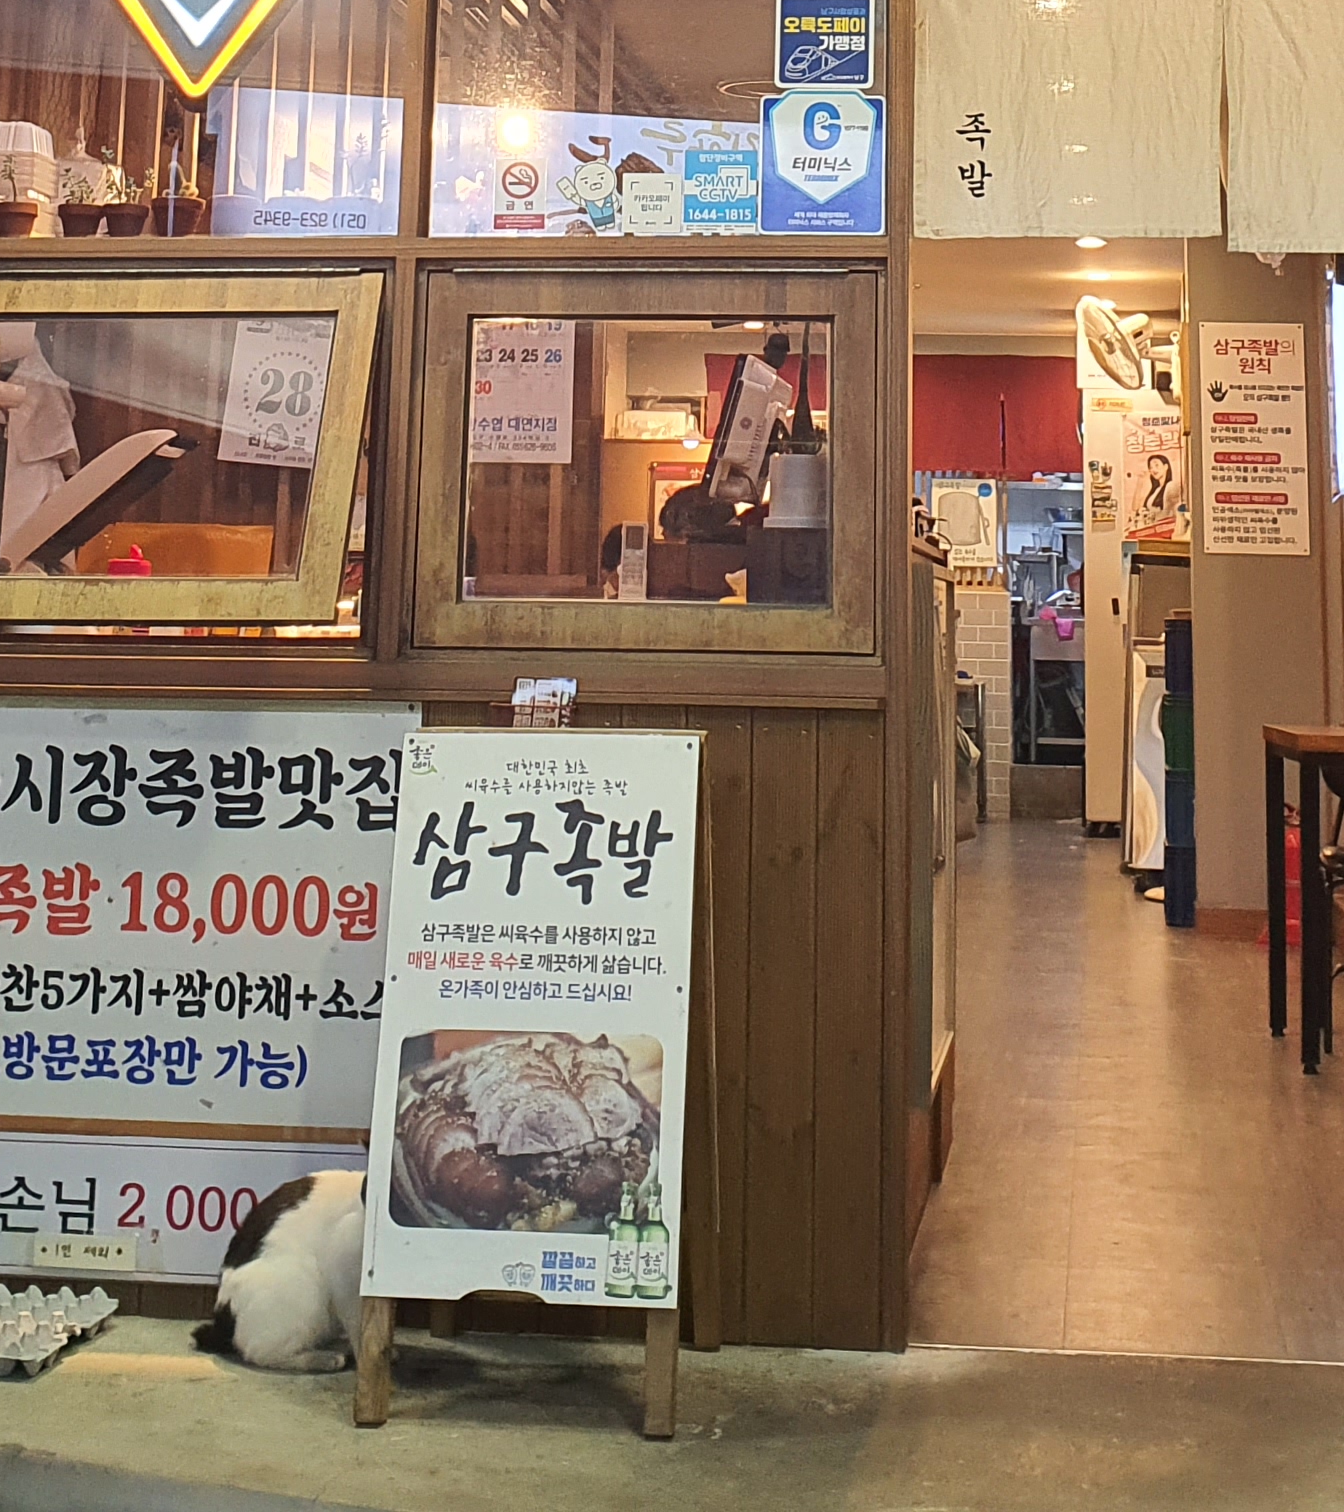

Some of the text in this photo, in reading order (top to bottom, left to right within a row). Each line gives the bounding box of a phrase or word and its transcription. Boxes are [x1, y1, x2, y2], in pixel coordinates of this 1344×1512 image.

[818, 35, 866, 51] 가맹점
[792, 156, 852, 172] 터미닉스
[955, 111, 994, 199] 족발
[694, 175, 744, 188] SMART
[699, 188, 738, 202] CCTV
[687, 208, 752, 221] 1644-1815
[498, 348, 516, 363] 24
[521, 348, 539, 363] 25
[544, 349, 563, 363] 26
[1213, 338, 1296, 357] 삼구족발의
[1238, 357, 1272, 375] 원칙
[255, 368, 315, 417] 28
[474, 380, 493, 395] 30
[508, 416, 558, 433] 대연지점
[505, 759, 590, 776] 대한민국 최초
[464, 778, 513, 796] 씨육수를
[602, 780, 629, 797] 족발
[413, 798, 675, 906] 삼구족발
[120, 869, 379, 945] 18,000원
[421, 923, 658, 946] 삼구족발은 씨육수를 사용하지 않고
[407, 950, 667, 976] 매일 새로운 육수로 깨끗하게 삶습니다.
[439, 979, 632, 1003] 온가족이 안심하고 드십시요!
[214, 1039, 310, 1090] 가능)
